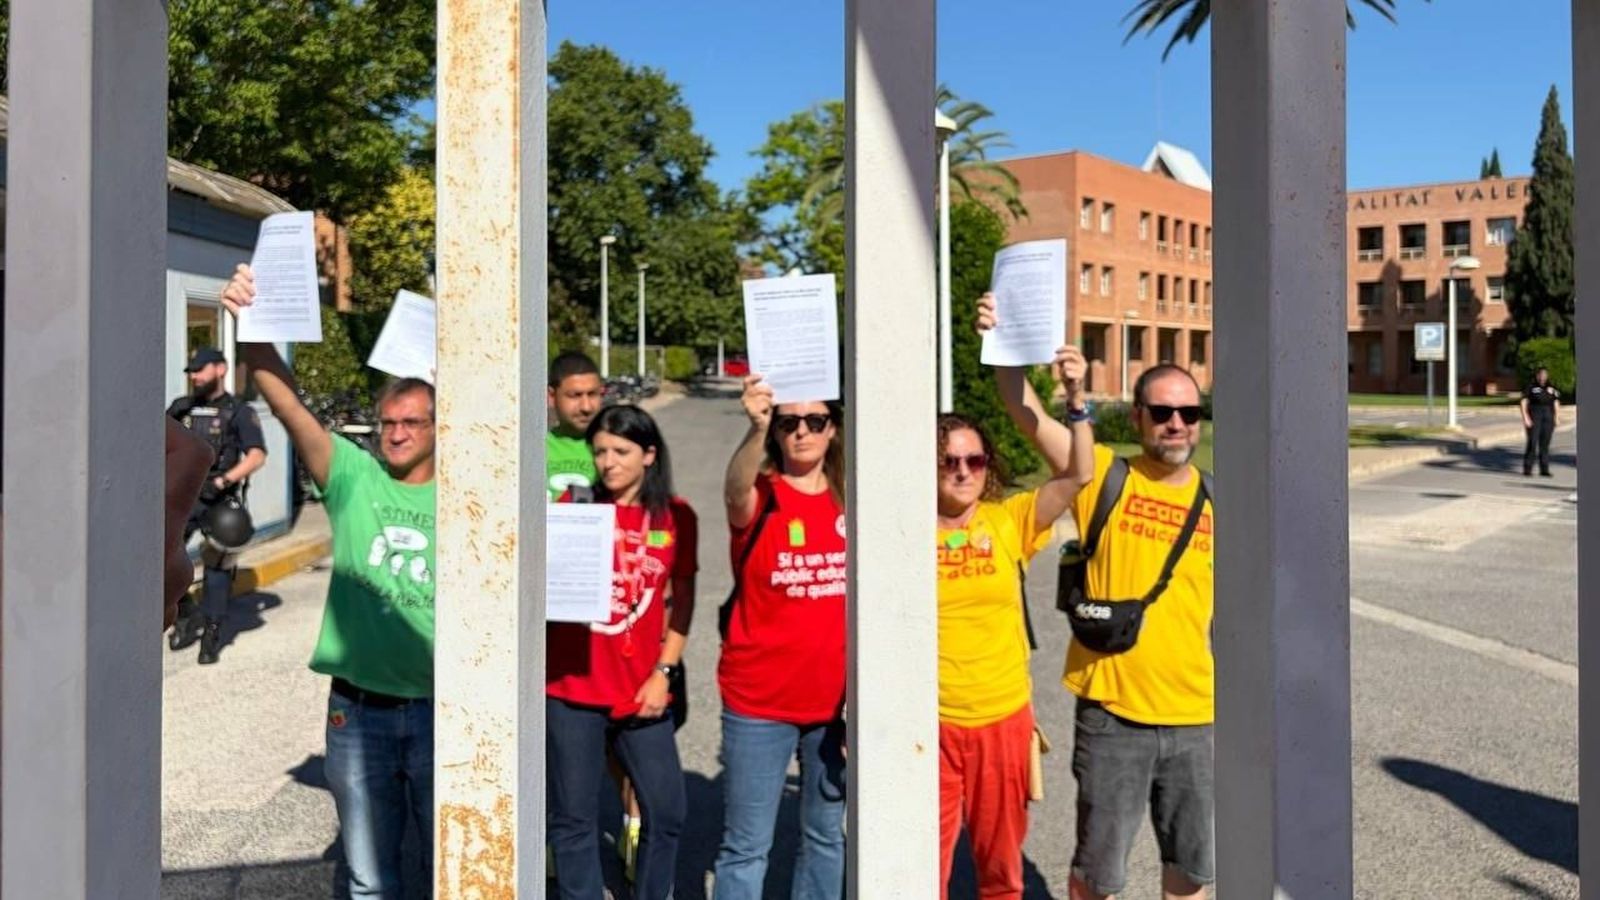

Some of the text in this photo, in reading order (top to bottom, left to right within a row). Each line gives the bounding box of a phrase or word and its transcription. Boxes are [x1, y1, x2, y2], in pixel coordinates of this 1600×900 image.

[1355, 189, 1431, 210] ALITAT
[1421, 328, 1438, 346] P
[794, 554, 804, 568] a
[805, 553, 824, 567] un
[786, 584, 806, 598] de
